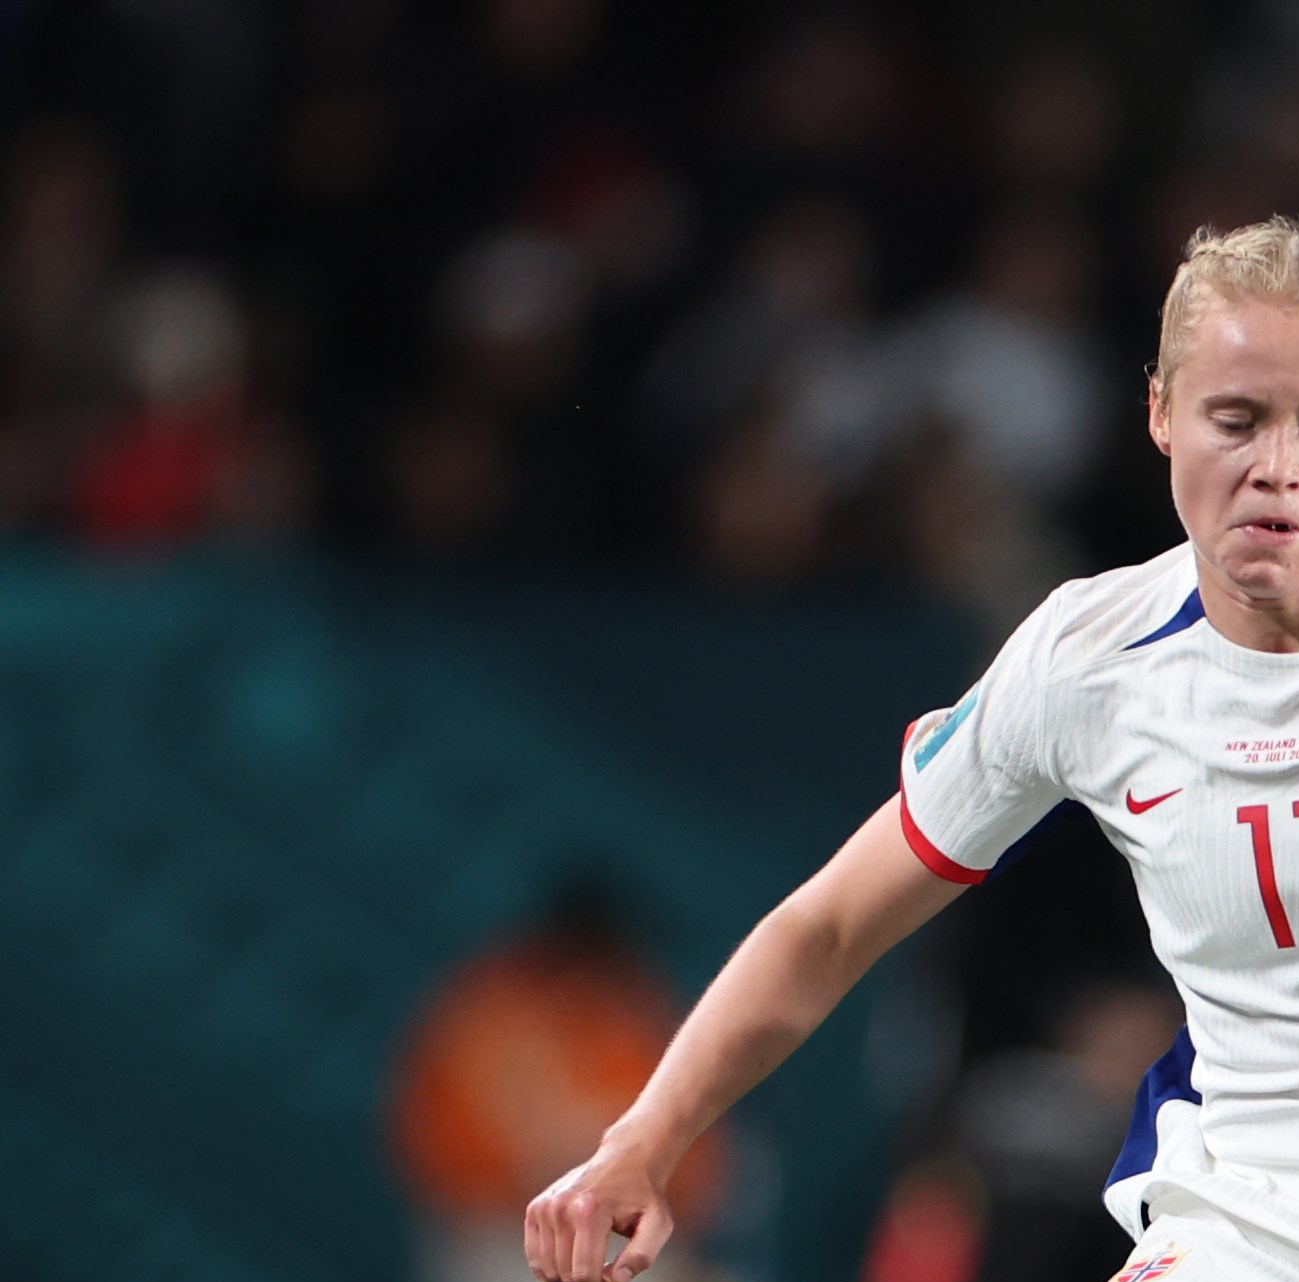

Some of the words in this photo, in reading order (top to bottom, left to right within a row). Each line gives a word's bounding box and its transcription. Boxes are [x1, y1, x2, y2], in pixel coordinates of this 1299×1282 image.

[1225, 741, 1249, 751] NEW
[1251, 738, 1297, 751] ZEALAND
[1264, 751, 1286, 763] JULI
